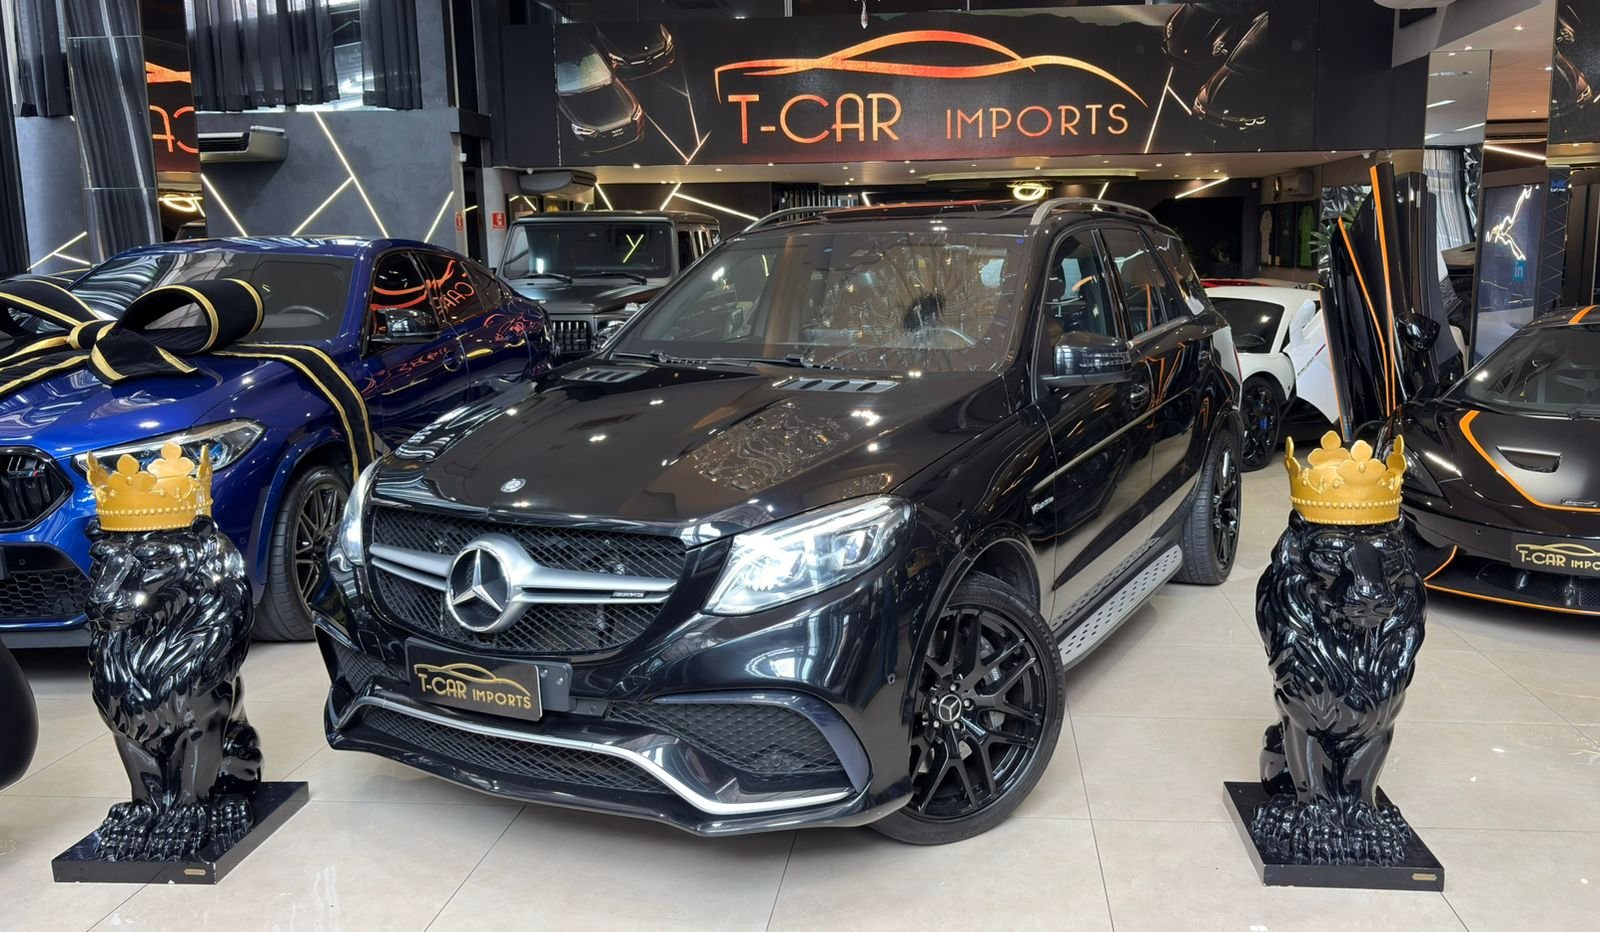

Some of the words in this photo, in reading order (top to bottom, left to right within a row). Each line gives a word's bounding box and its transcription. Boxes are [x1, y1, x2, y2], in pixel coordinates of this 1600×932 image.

[728, 92, 902, 144] T-CAR
[946, 103, 1129, 140] IMPORTS
[1518, 550, 1566, 567] T-CAR
[417, 673, 468, 699] T-CAR
[472, 688, 532, 709] IMPORTS
